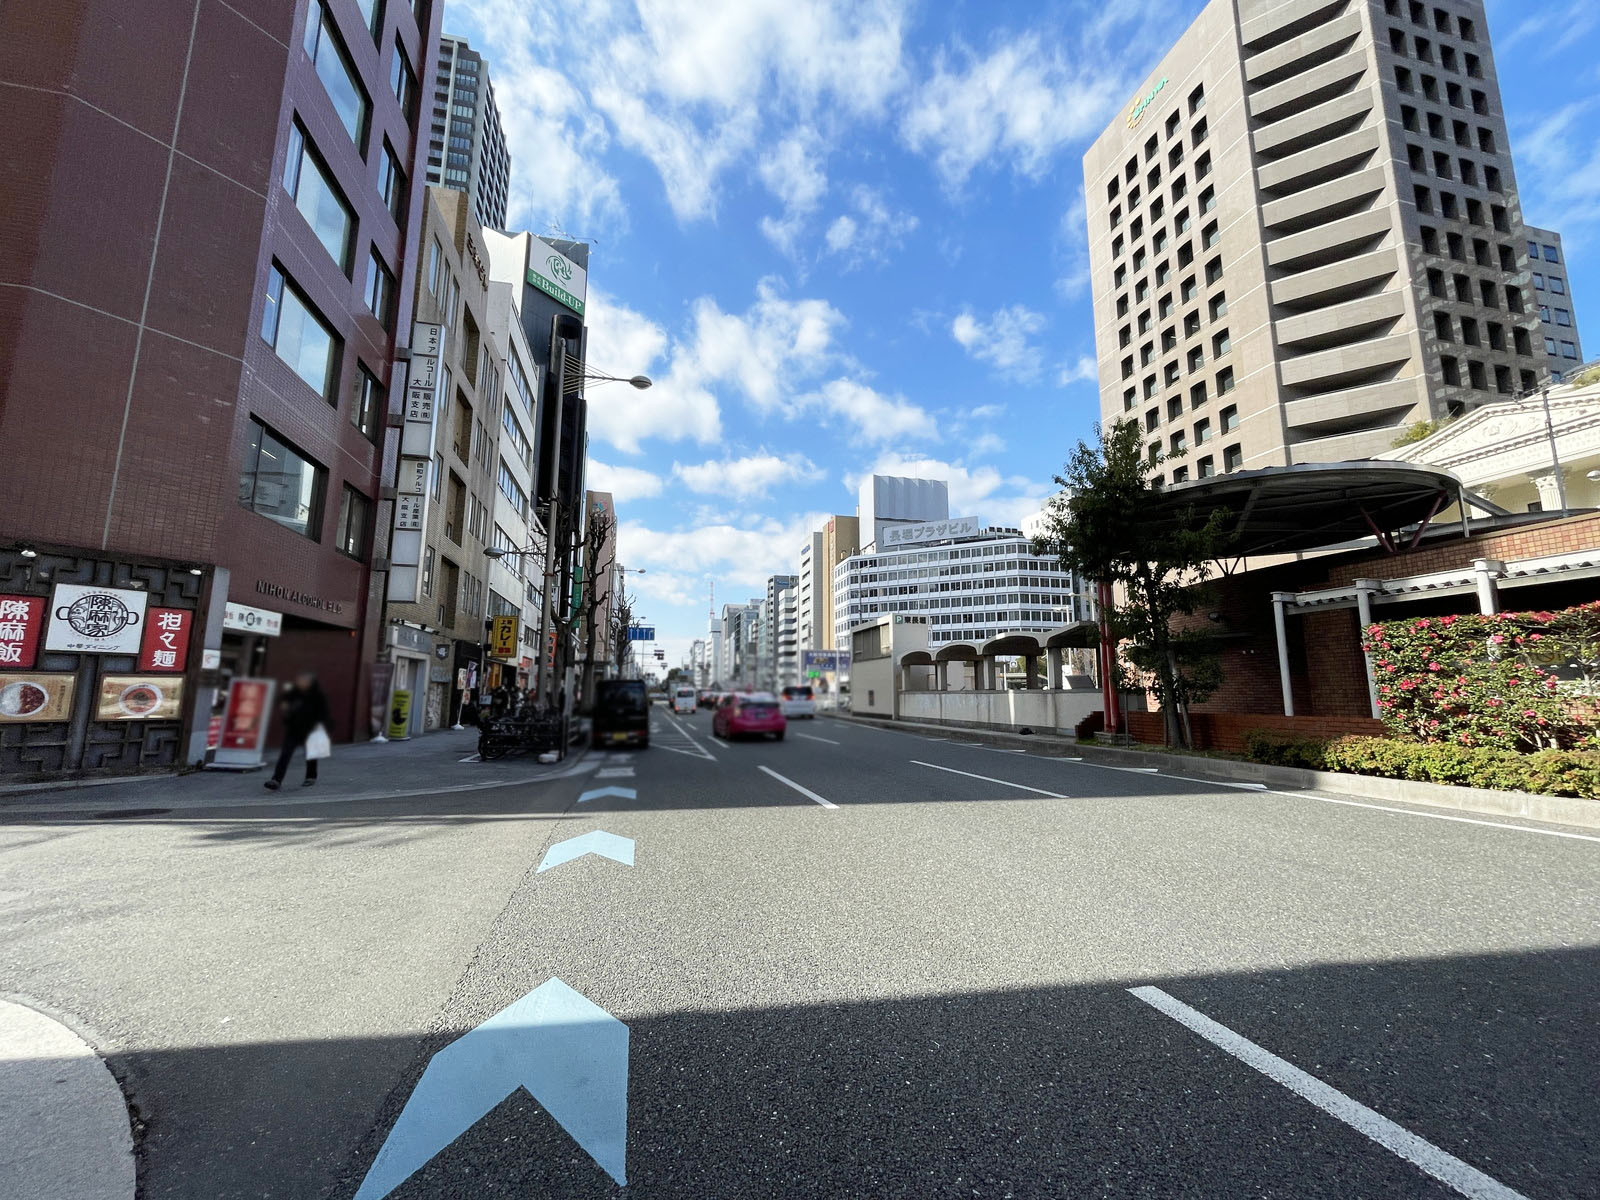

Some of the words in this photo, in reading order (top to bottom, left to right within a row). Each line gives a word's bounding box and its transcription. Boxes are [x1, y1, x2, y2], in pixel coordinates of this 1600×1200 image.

[541, 279, 582, 310] Build-UP
[409, 378, 422, 419] 大阪支店
[889, 522, 973, 542] 長堀プラザビル
[256, 580, 290, 600] NIHON
[291, 590, 326, 610] ALCOHOL
[0, 600, 31, 663] 陳麻飯
[86, 595, 113, 637] 陳麻家
[152, 612, 183, 668] 担々麺
[500, 625, 511, 646] カレー
